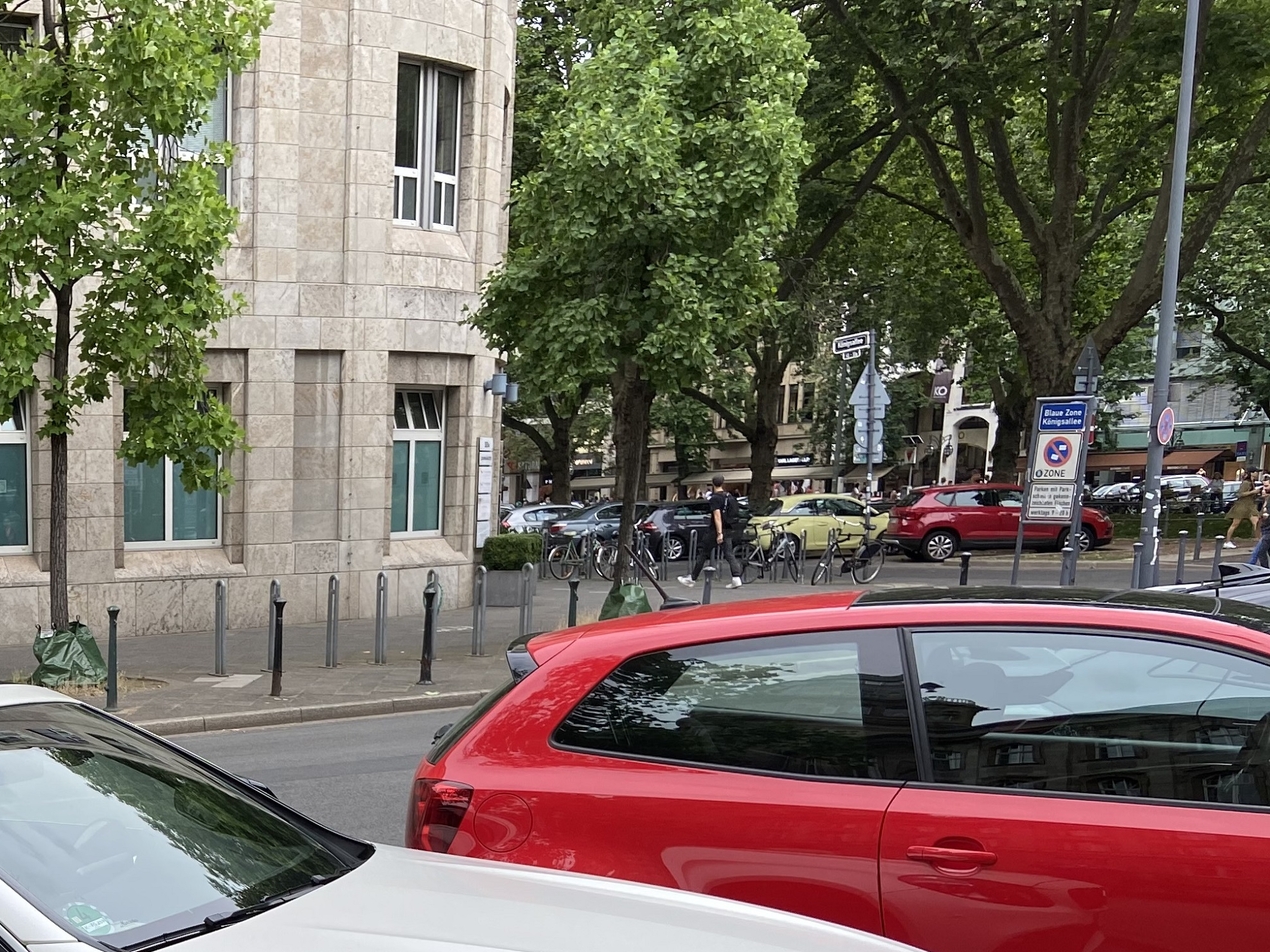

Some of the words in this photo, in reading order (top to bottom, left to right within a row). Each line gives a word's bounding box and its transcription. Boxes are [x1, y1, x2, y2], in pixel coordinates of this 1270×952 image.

[1044, 409, 1064, 417] Blaue
[1065, 408, 1083, 417] Zone
[1042, 417, 1082, 427] Königsallee
[1043, 469, 1066, 478] ZONE
